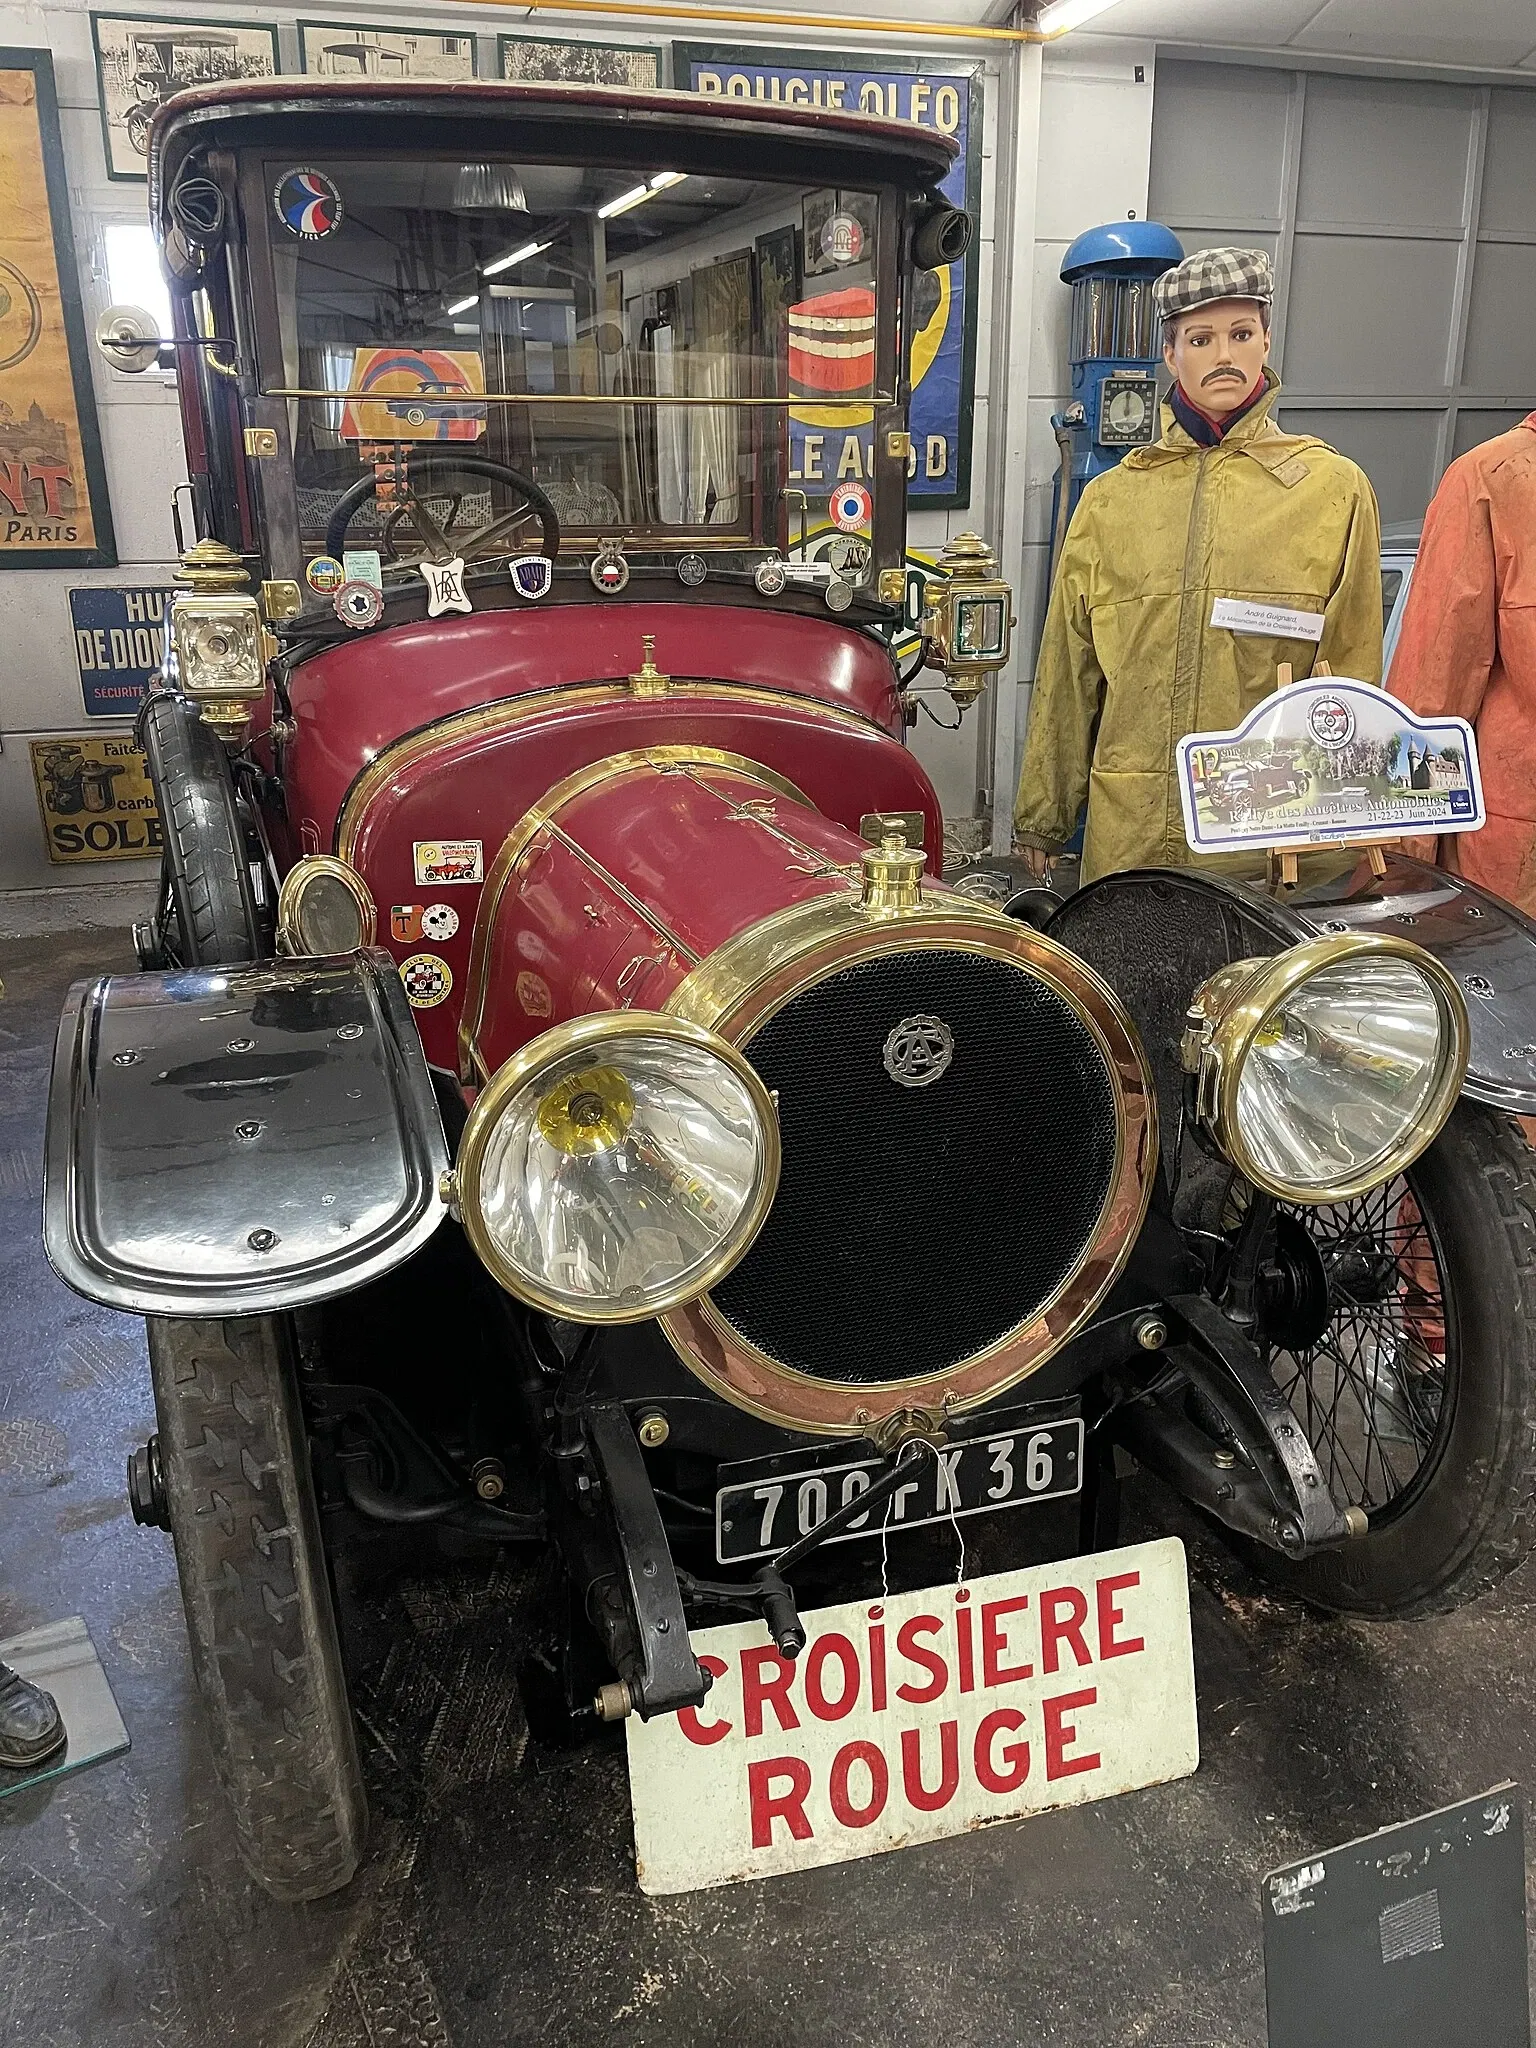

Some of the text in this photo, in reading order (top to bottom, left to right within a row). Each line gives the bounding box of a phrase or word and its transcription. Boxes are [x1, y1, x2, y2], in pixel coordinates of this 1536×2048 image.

[859, 79, 960, 134] OLÉO
[4, 520, 77, 542] PARIS
[1245, 610, 1298, 623] André Guignard,
[1298, 626, 1316, 634] Rouge
[77, 629, 110, 670] DE
[94, 686, 145, 698] SÉCURITÉ
[104, 743, 146, 756] Faites
[1193, 747, 1222, 778] 12
[1229, 795, 1446, 823] Rallye des Ancêtres Automobiles
[1368, 808, 1447, 821] 21-22-23 Juin 2024
[396, 916, 411, 933] T
[441, 906, 458, 930] TOPOLINO
[406, 958, 424, 968] CLUB
[987, 1432, 1053, 1500] 36
[676, 1571, 1145, 1746] CROISIERE
[747, 1687, 1101, 1849] ROUGE
